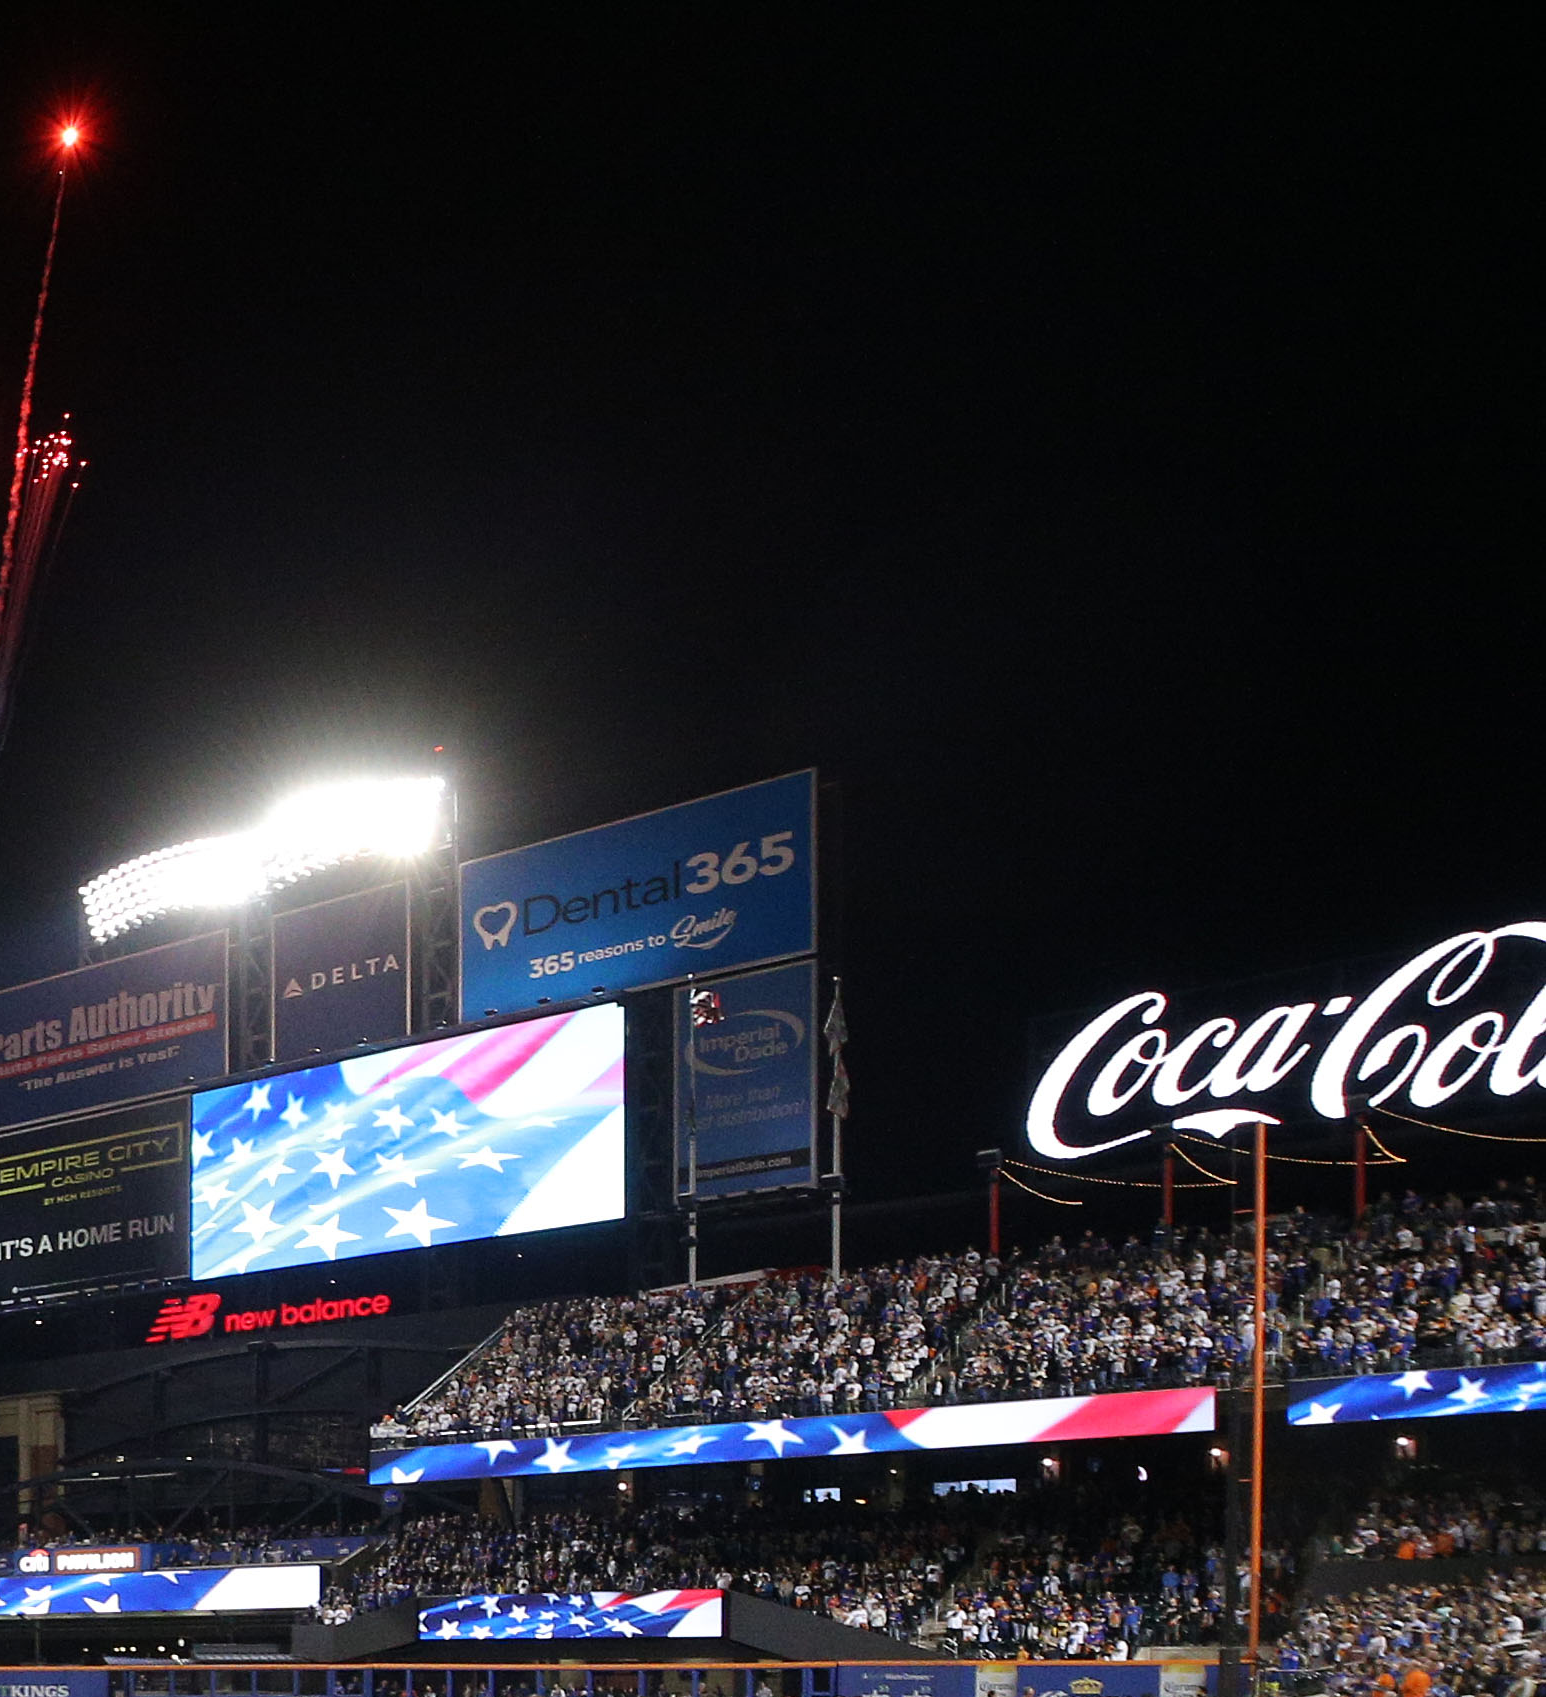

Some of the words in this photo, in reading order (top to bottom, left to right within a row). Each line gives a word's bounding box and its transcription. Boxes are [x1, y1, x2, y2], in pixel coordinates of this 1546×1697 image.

[521, 830, 796, 937] Dental365
[528, 951, 575, 979] 365
[578, 939, 644, 964] reasons
[647, 933, 666, 948] to
[670, 907, 738, 949] Smile
[311, 953, 399, 990] DELTA
[69, 981, 218, 1044] Authority
[36, 1048, 83, 1067] Parts
[86, 1035, 142, 1055] Super
[145, 1017, 210, 1041] Stores
[699, 1023, 781, 1053] Imperial
[735, 1038, 789, 1062] Dade
[1027, 920, 1546, 1159] Coca-Col
[56, 1060, 114, 1083] Answer
[0, 1151, 100, 1184] EMPIRE
[108, 1137, 170, 1162] CITY
[51, 1167, 114, 1188] CASINO
[37, 1235, 54, 1255] A
[57, 1222, 122, 1251] HOME
[128, 1213, 176, 1239] RUN
[224, 1309, 276, 1332] new
[280, 1294, 392, 1326] balance
